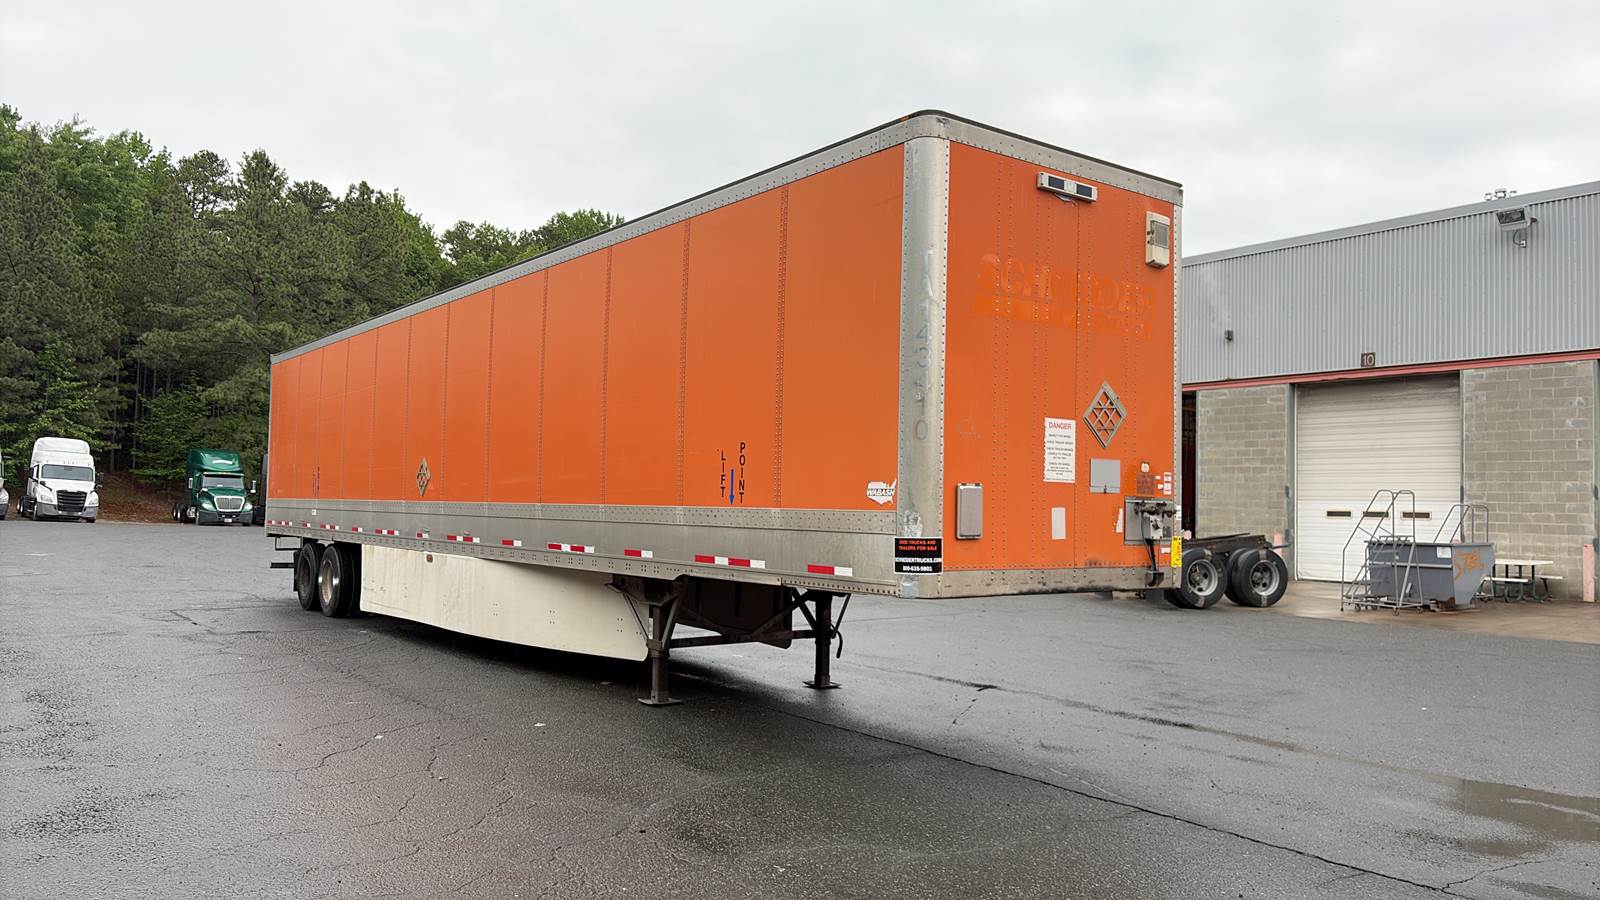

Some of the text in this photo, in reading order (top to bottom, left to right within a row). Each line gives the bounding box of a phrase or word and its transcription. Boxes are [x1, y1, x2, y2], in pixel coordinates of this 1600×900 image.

[1363, 354, 1375, 367] 10
[1048, 421, 1073, 430] DANGER
[867, 488, 895, 497] WABASH
